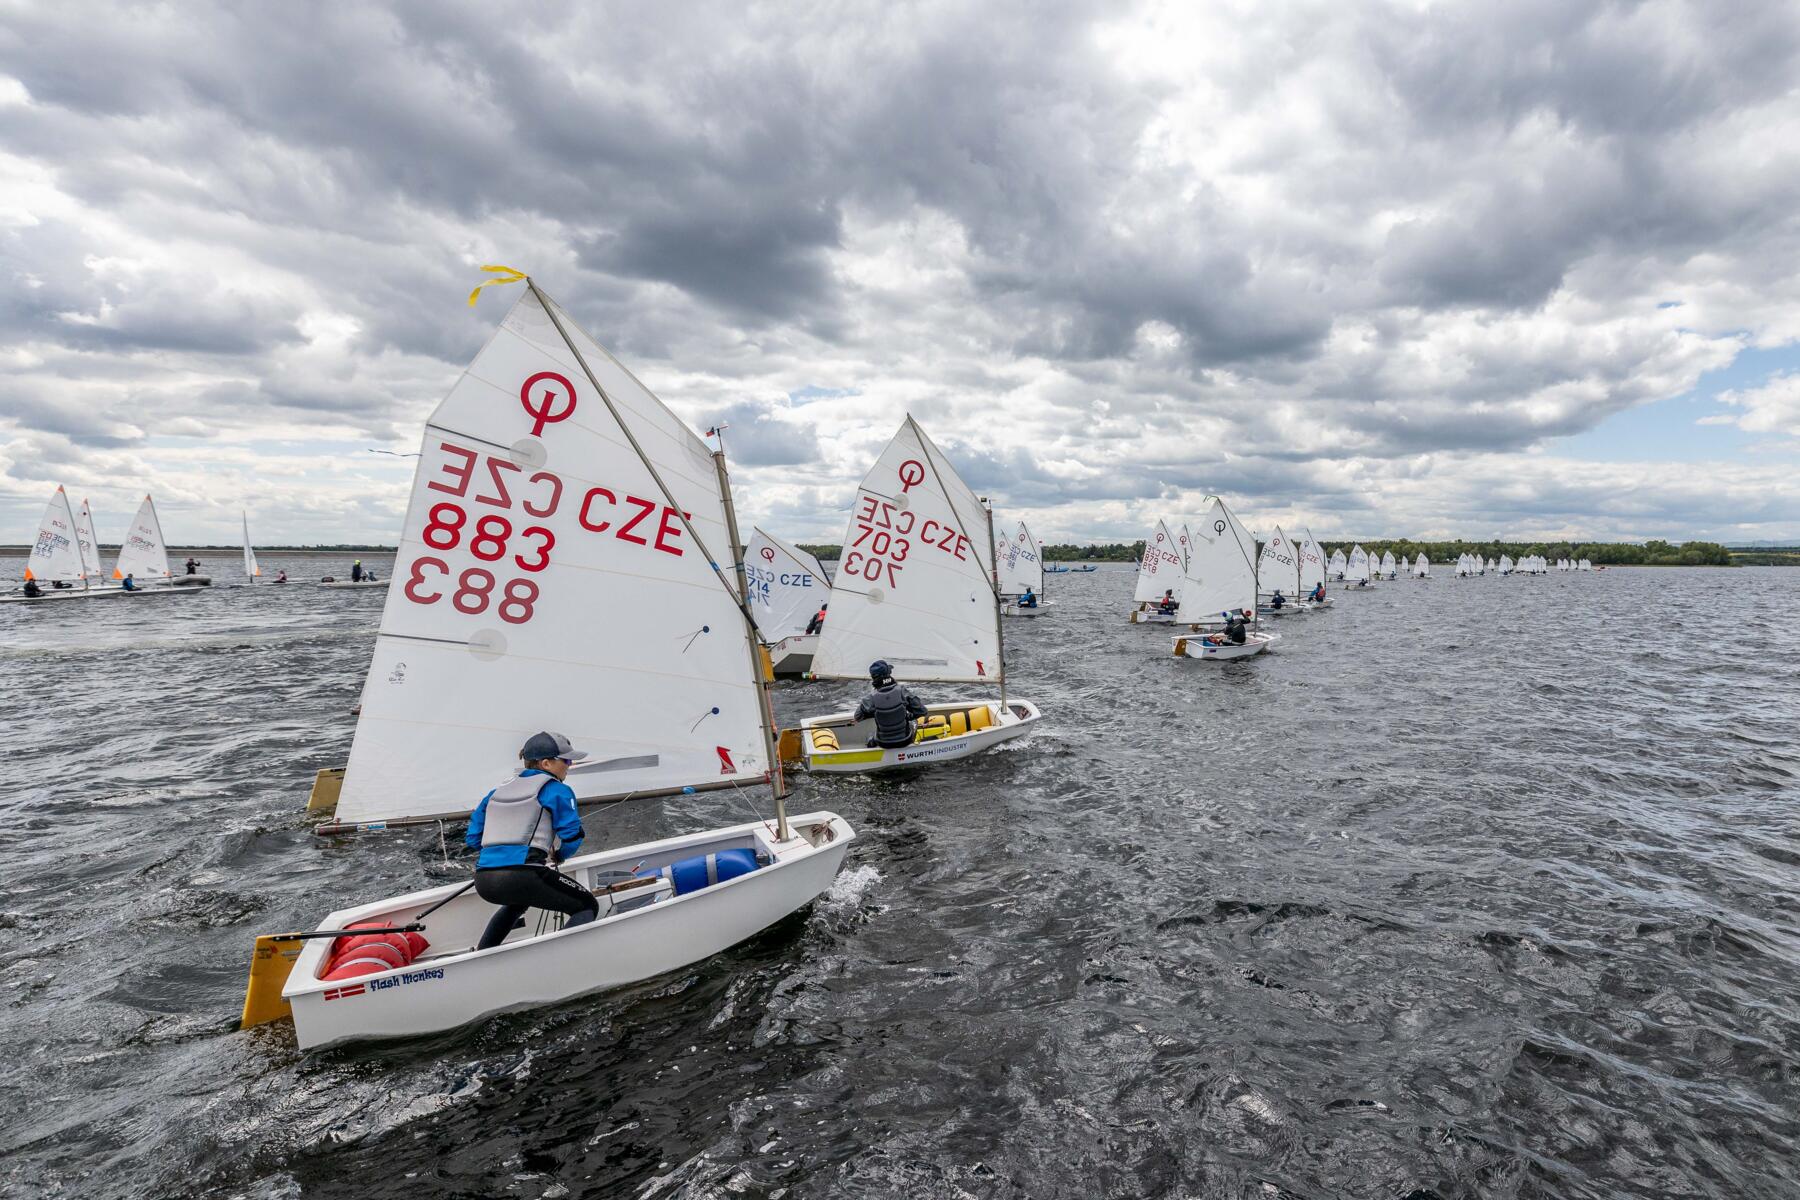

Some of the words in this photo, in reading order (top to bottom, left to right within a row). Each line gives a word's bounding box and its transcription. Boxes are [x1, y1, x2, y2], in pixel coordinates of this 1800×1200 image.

[578, 487, 692, 557] CZE
[422, 502, 556, 572] 883
[851, 524, 910, 562] 703
[920, 520, 972, 562] CZE
[1021, 550, 1037, 562] CZE
[1162, 552, 1180, 565] CZE
[1277, 554, 1292, 566] CZE
[748, 576, 770, 594] 714
[780, 573, 813, 587] CZE
